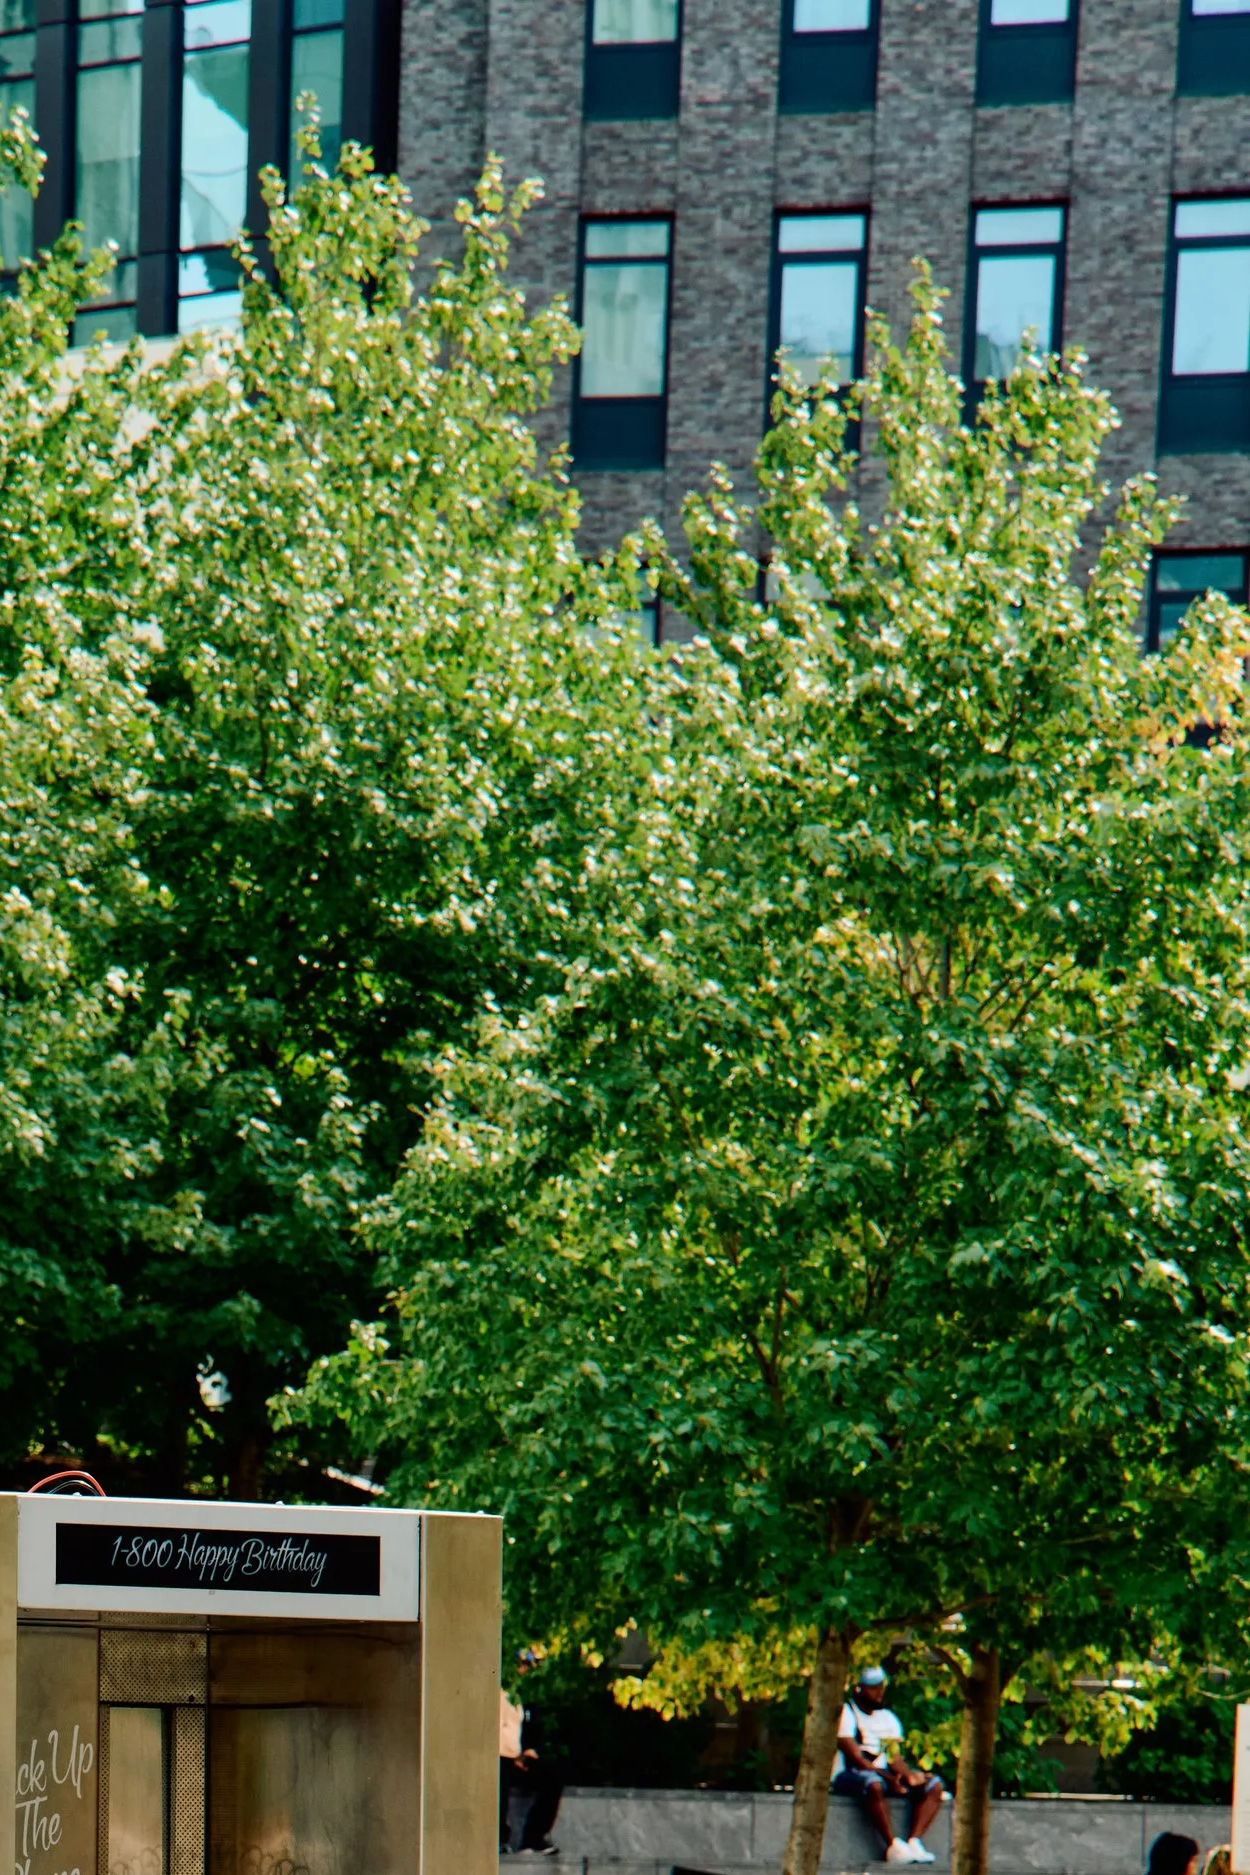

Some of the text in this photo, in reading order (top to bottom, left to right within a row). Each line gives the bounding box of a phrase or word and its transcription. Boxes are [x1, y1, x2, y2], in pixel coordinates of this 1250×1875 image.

[111, 1532, 328, 1588] 1-800 Happy Birthday
[48, 1725, 94, 1799] Up
[15, 1796, 62, 1858] The
